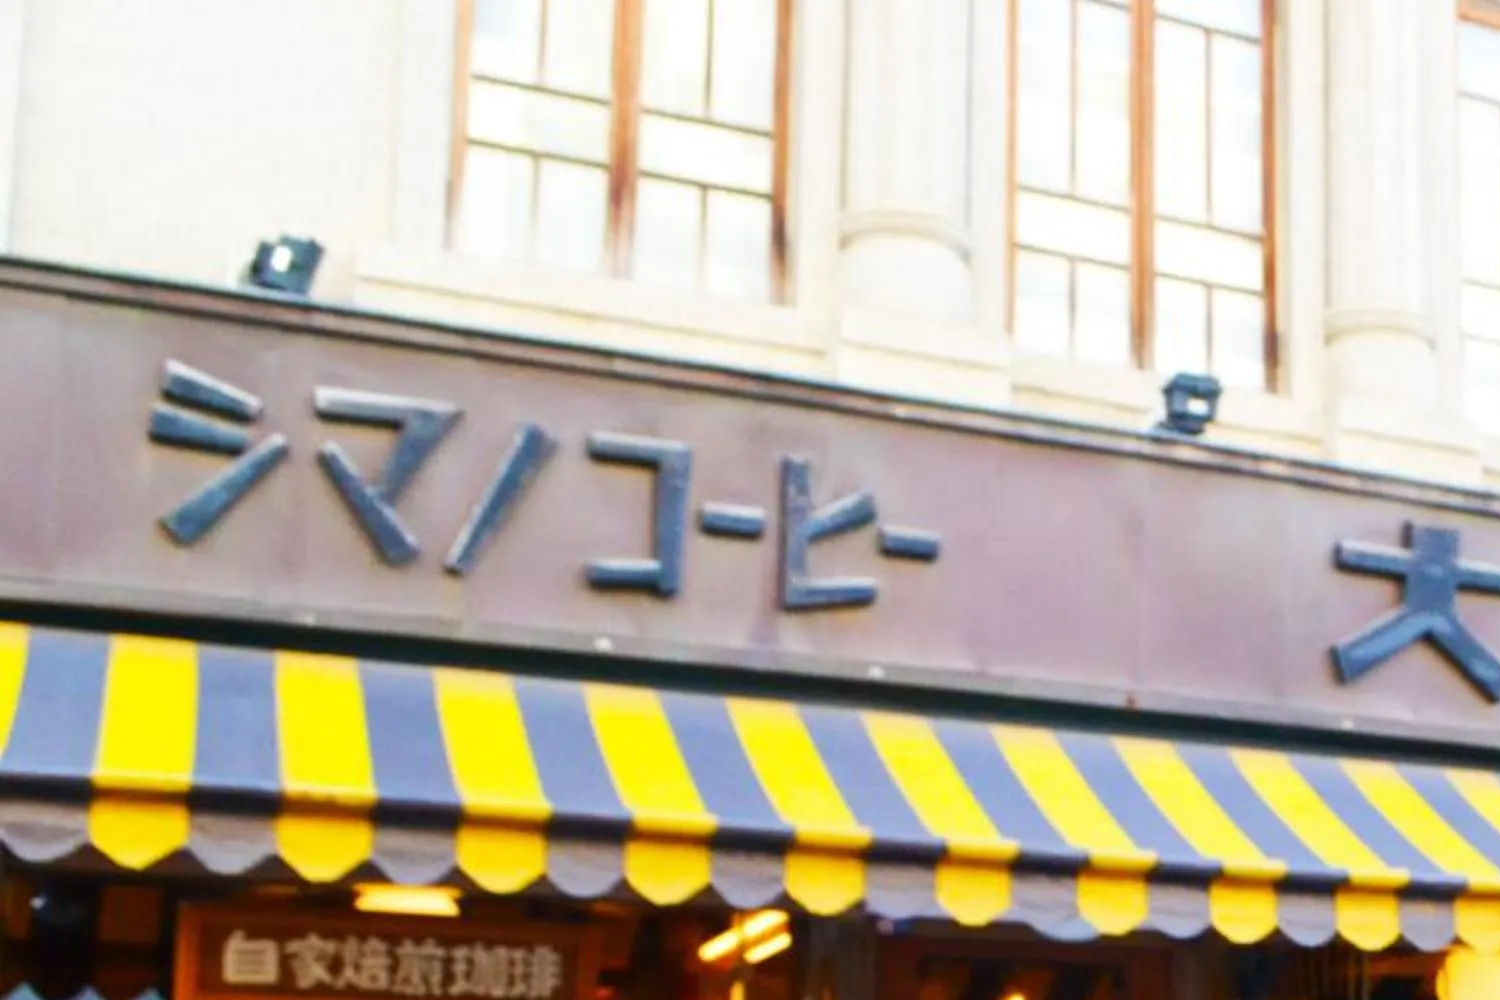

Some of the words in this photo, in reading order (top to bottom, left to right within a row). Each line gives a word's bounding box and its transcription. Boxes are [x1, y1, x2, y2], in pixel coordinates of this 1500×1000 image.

[148, 358, 941, 611] シマノコーヒー
